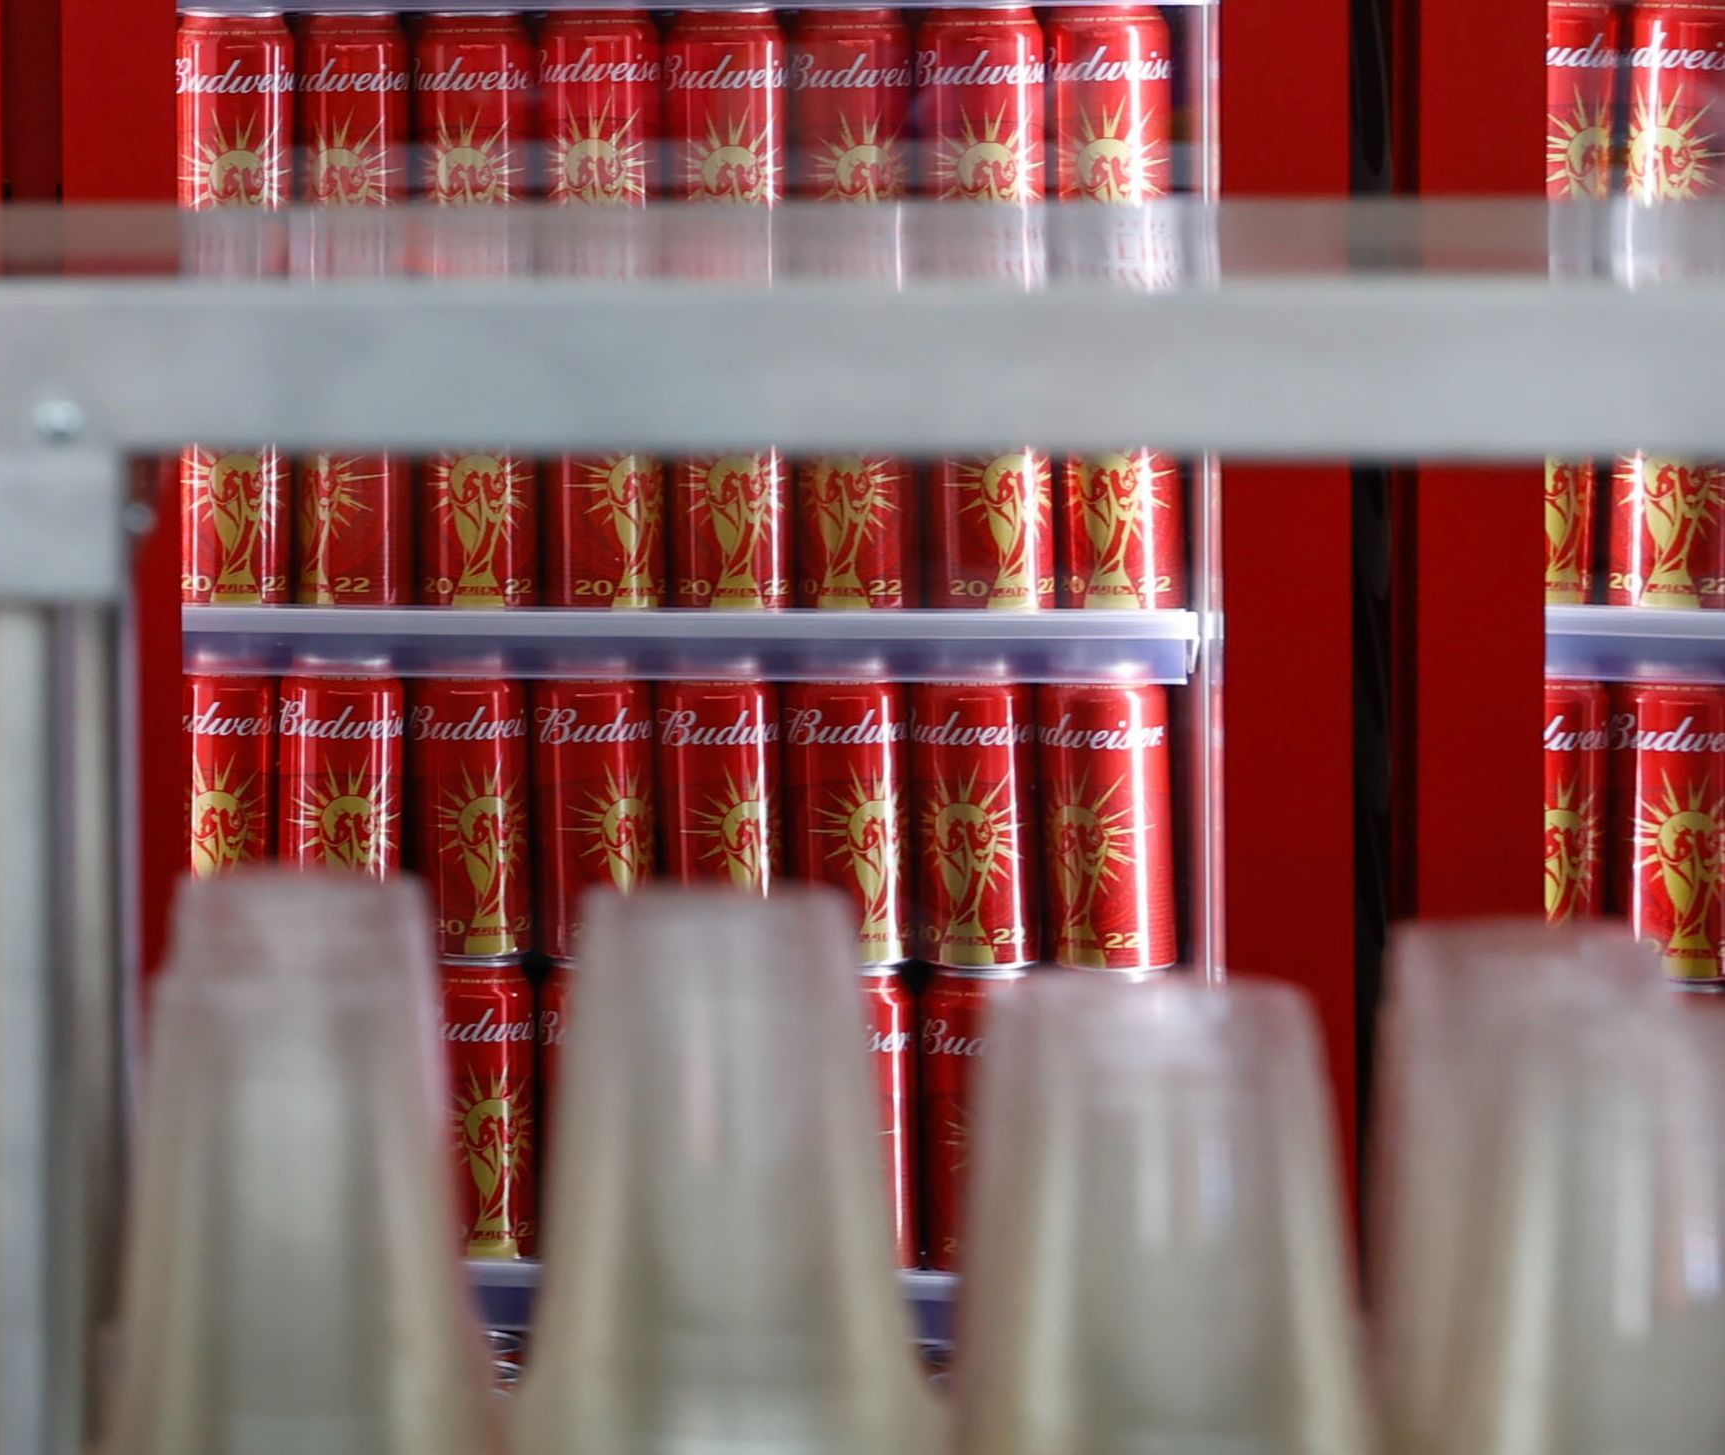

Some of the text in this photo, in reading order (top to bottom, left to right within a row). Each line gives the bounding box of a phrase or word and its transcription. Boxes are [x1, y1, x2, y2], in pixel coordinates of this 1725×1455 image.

[334, 577, 370, 592] 22
[575, 579, 613, 595] 20
[871, 580, 903, 595] 22
[950, 580, 989, 596] 20
